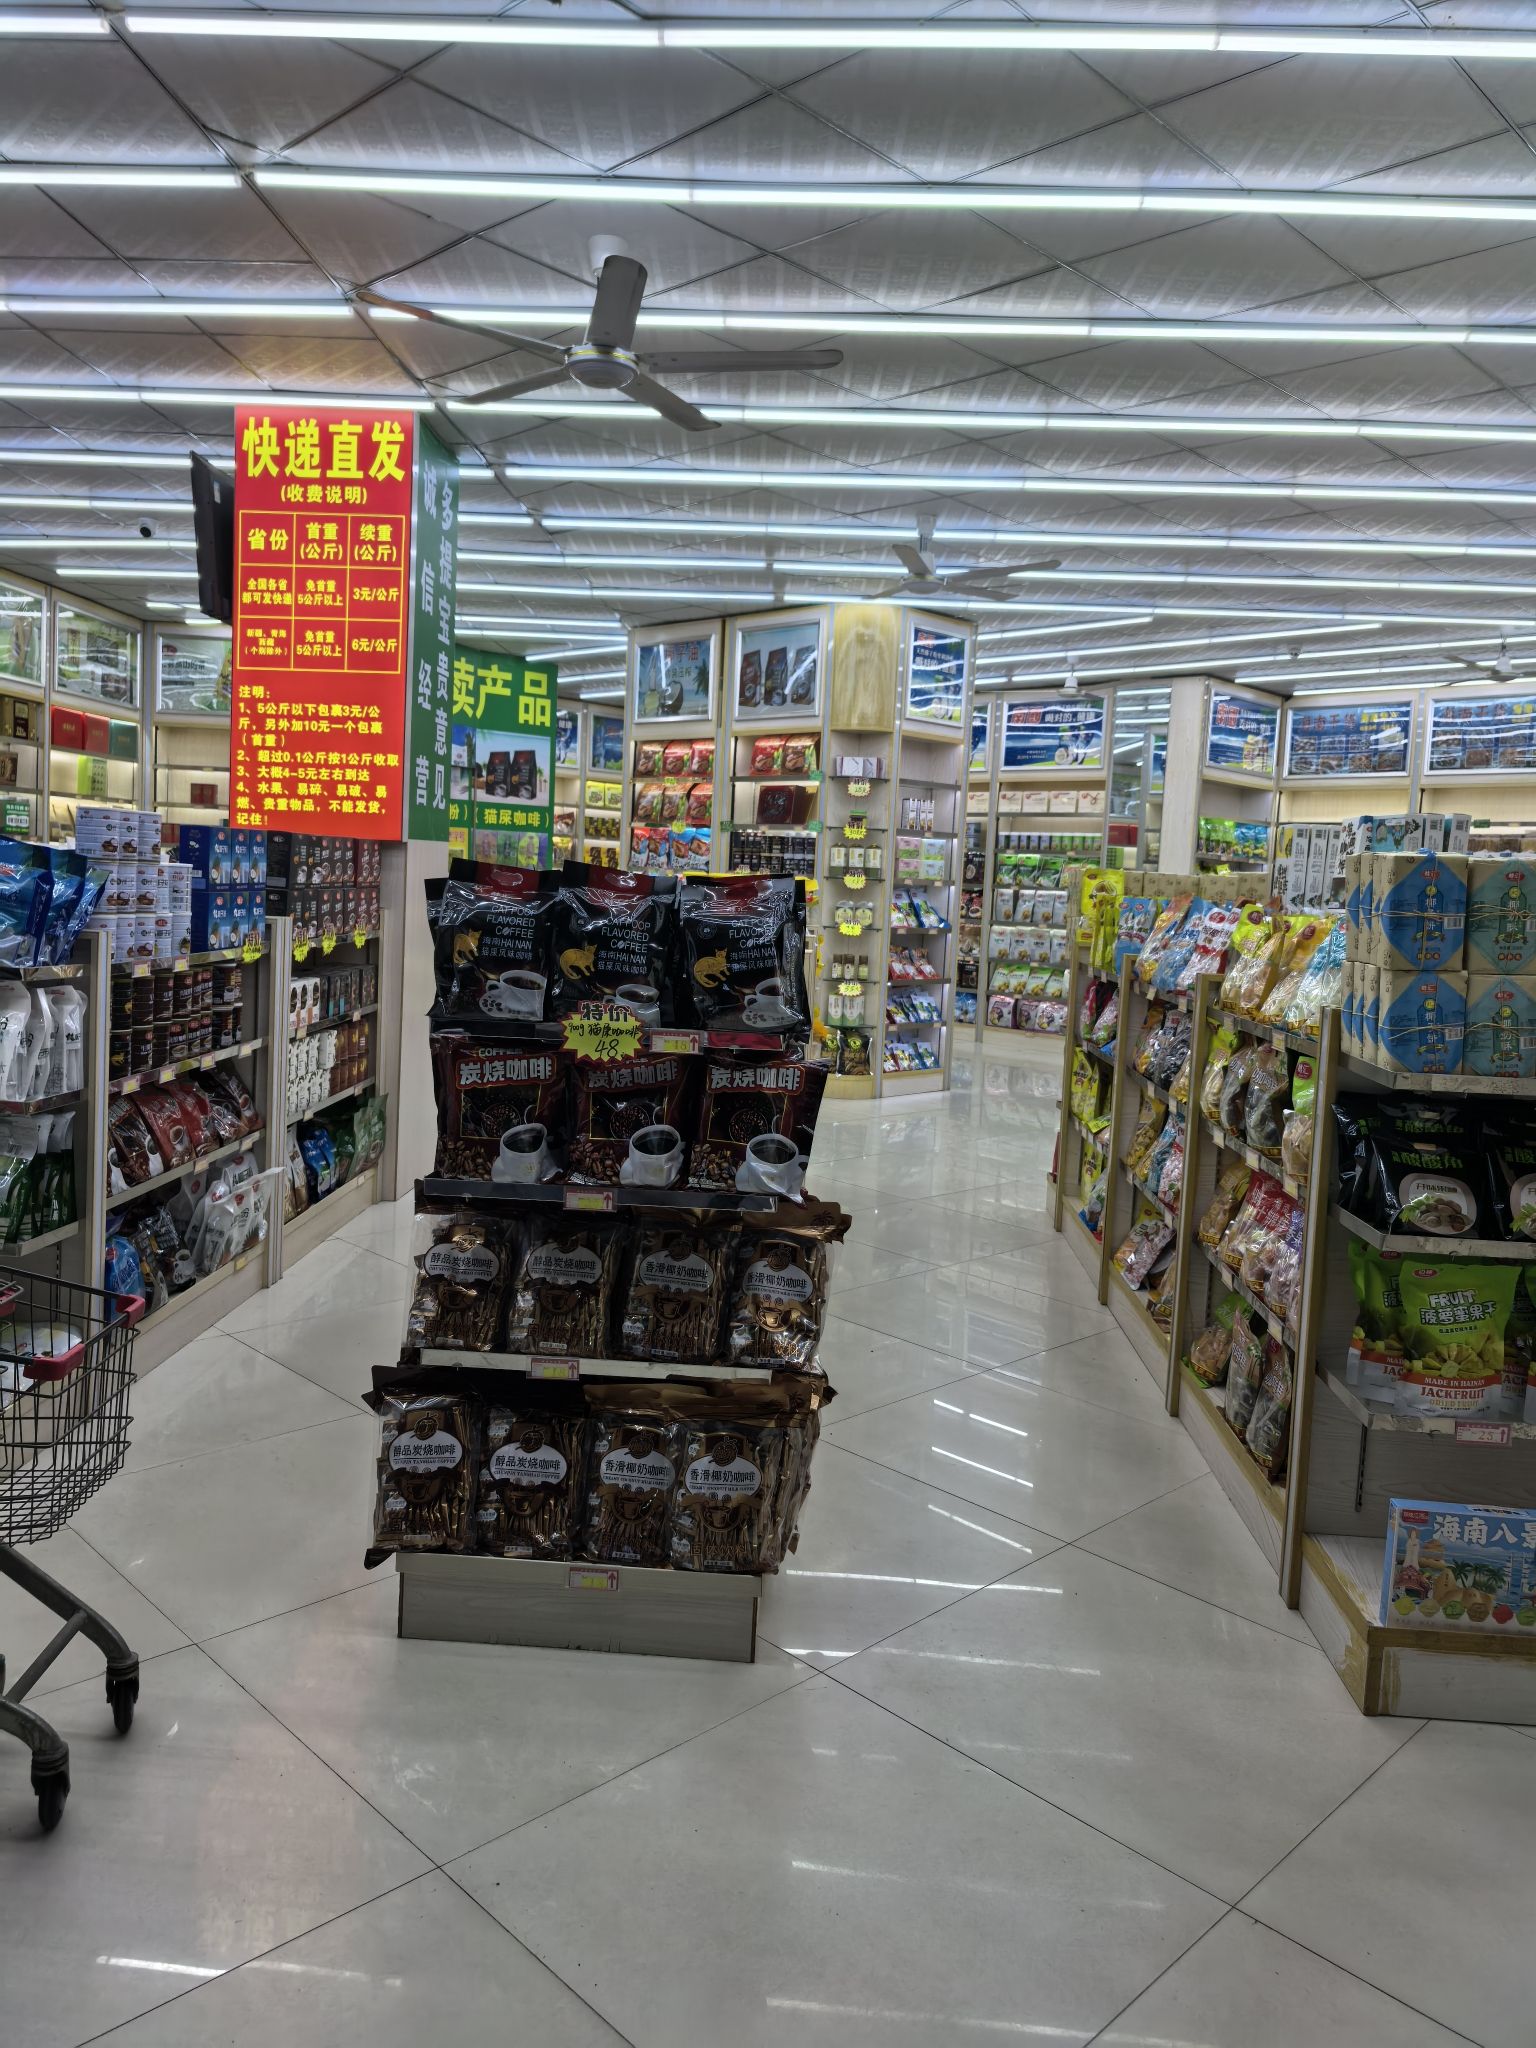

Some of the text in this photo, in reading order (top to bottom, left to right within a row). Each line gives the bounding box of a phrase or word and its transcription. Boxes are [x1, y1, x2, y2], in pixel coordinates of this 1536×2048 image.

[242, 416, 406, 481] 快递直发
[281, 484, 367, 504] (收费说明)
[247, 528, 289, 551] 省份
[306, 522, 338, 540] 首重
[359, 523, 392, 542] 续重
[300, 542, 343, 561] (公斤)
[354, 543, 397, 562] (公斤)
[247, 577, 288, 591] 全国各省
[305, 579, 337, 593] 免首重
[241, 591, 293, 606] 都可发快递
[297, 593, 344, 607] 5公斤以上
[352, 587, 400, 602] 3元/公斤
[304, 630, 336, 644] 免首重
[415, 460, 437, 806] 诚信经营
[296, 644, 343, 657] 5公斤以上
[351, 638, 398, 653] 6元/公斤
[433, 480, 453, 809] 多提宝贵意见
[452, 656, 552, 728] 卖产品
[486, 914, 536, 927] FLAVORED
[601, 927, 650, 942] FLAVORED
[580, 1002, 631, 1023] 特价
[459, 1056, 553, 1085] 炭烧咖啡
[588, 1061, 679, 1089] 炭烧咖啡
[711, 1066, 801, 1091] 炭烧咖啡
[532, 1255, 597, 1272] 醇品炭烧咖啡
[645, 1261, 709, 1280] 香滑椰奶咖啡
[746, 1271, 808, 1290] 香滑椰奶咖啡
[1428, 1290, 1475, 1308] FRUIT
[1420, 1302, 1497, 1325] 菠萝蜜果干
[1424, 1376, 1449, 1387] MADE
[1420, 1386, 1486, 1399] JACKFRUIT
[393, 1444, 456, 1458] 醇品炭烧咖啡
[495, 1455, 562, 1471] 醇品炭烧咖啡
[690, 1468, 756, 1483] 香滑椰奶咖啡
[1433, 1514, 1536, 1550] 海南八景
